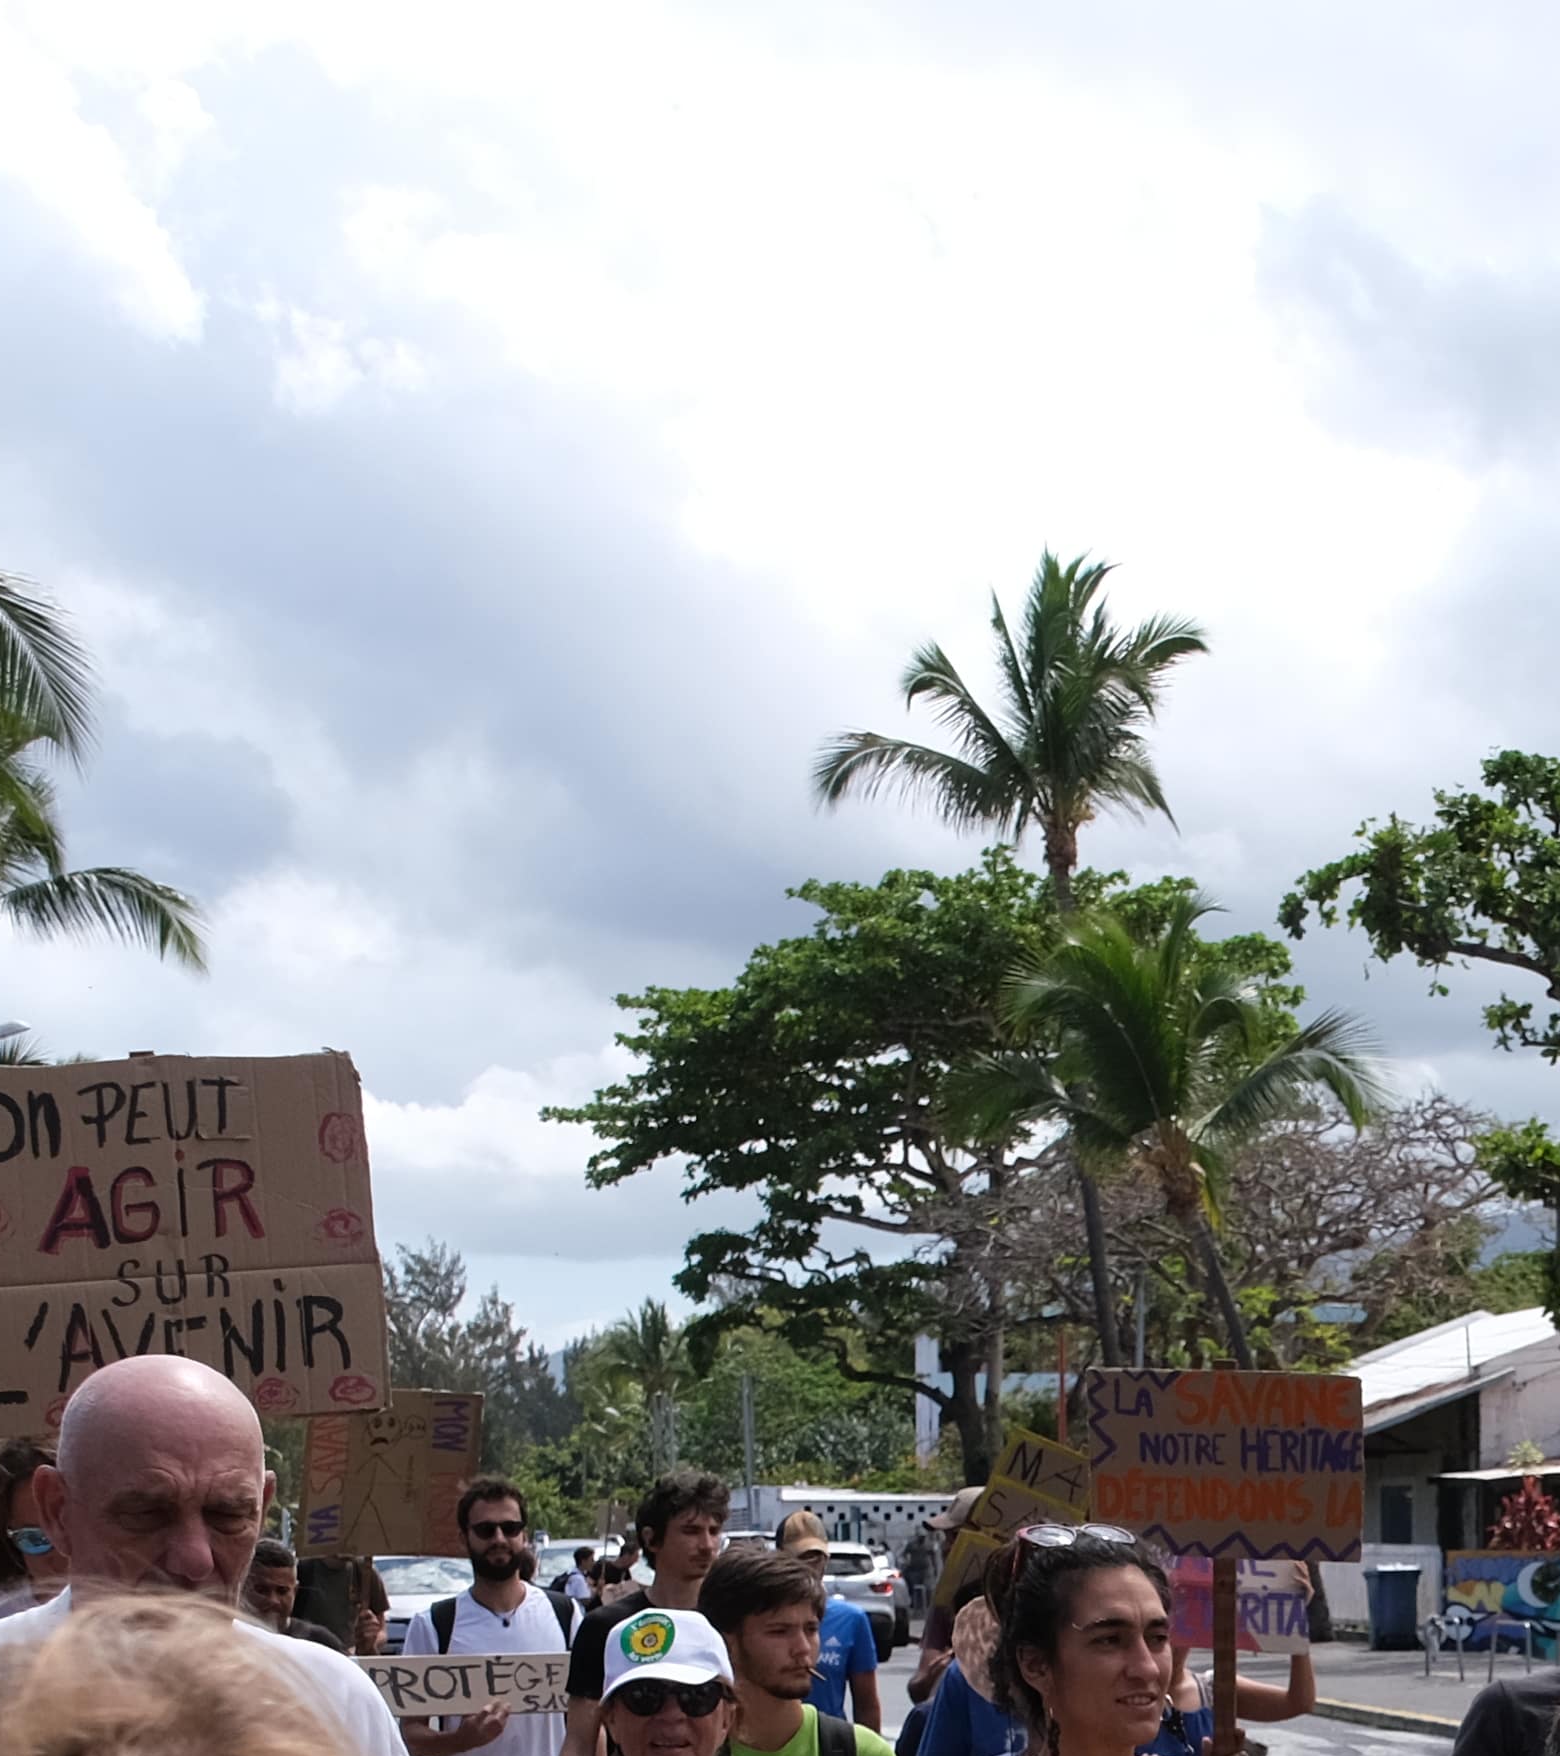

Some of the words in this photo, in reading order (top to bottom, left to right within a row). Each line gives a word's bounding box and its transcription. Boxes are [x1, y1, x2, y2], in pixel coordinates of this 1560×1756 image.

[77, 1075, 242, 1149] PEUT
[111, 1252, 232, 1308] SUR
[1114, 1378, 1154, 1419] LA
[1175, 1371, 1357, 1428] SAVANE
[1007, 1441, 1084, 1502] MA
[1141, 1432, 1227, 1467] NOTRE
[308, 1504, 342, 1545] MA
